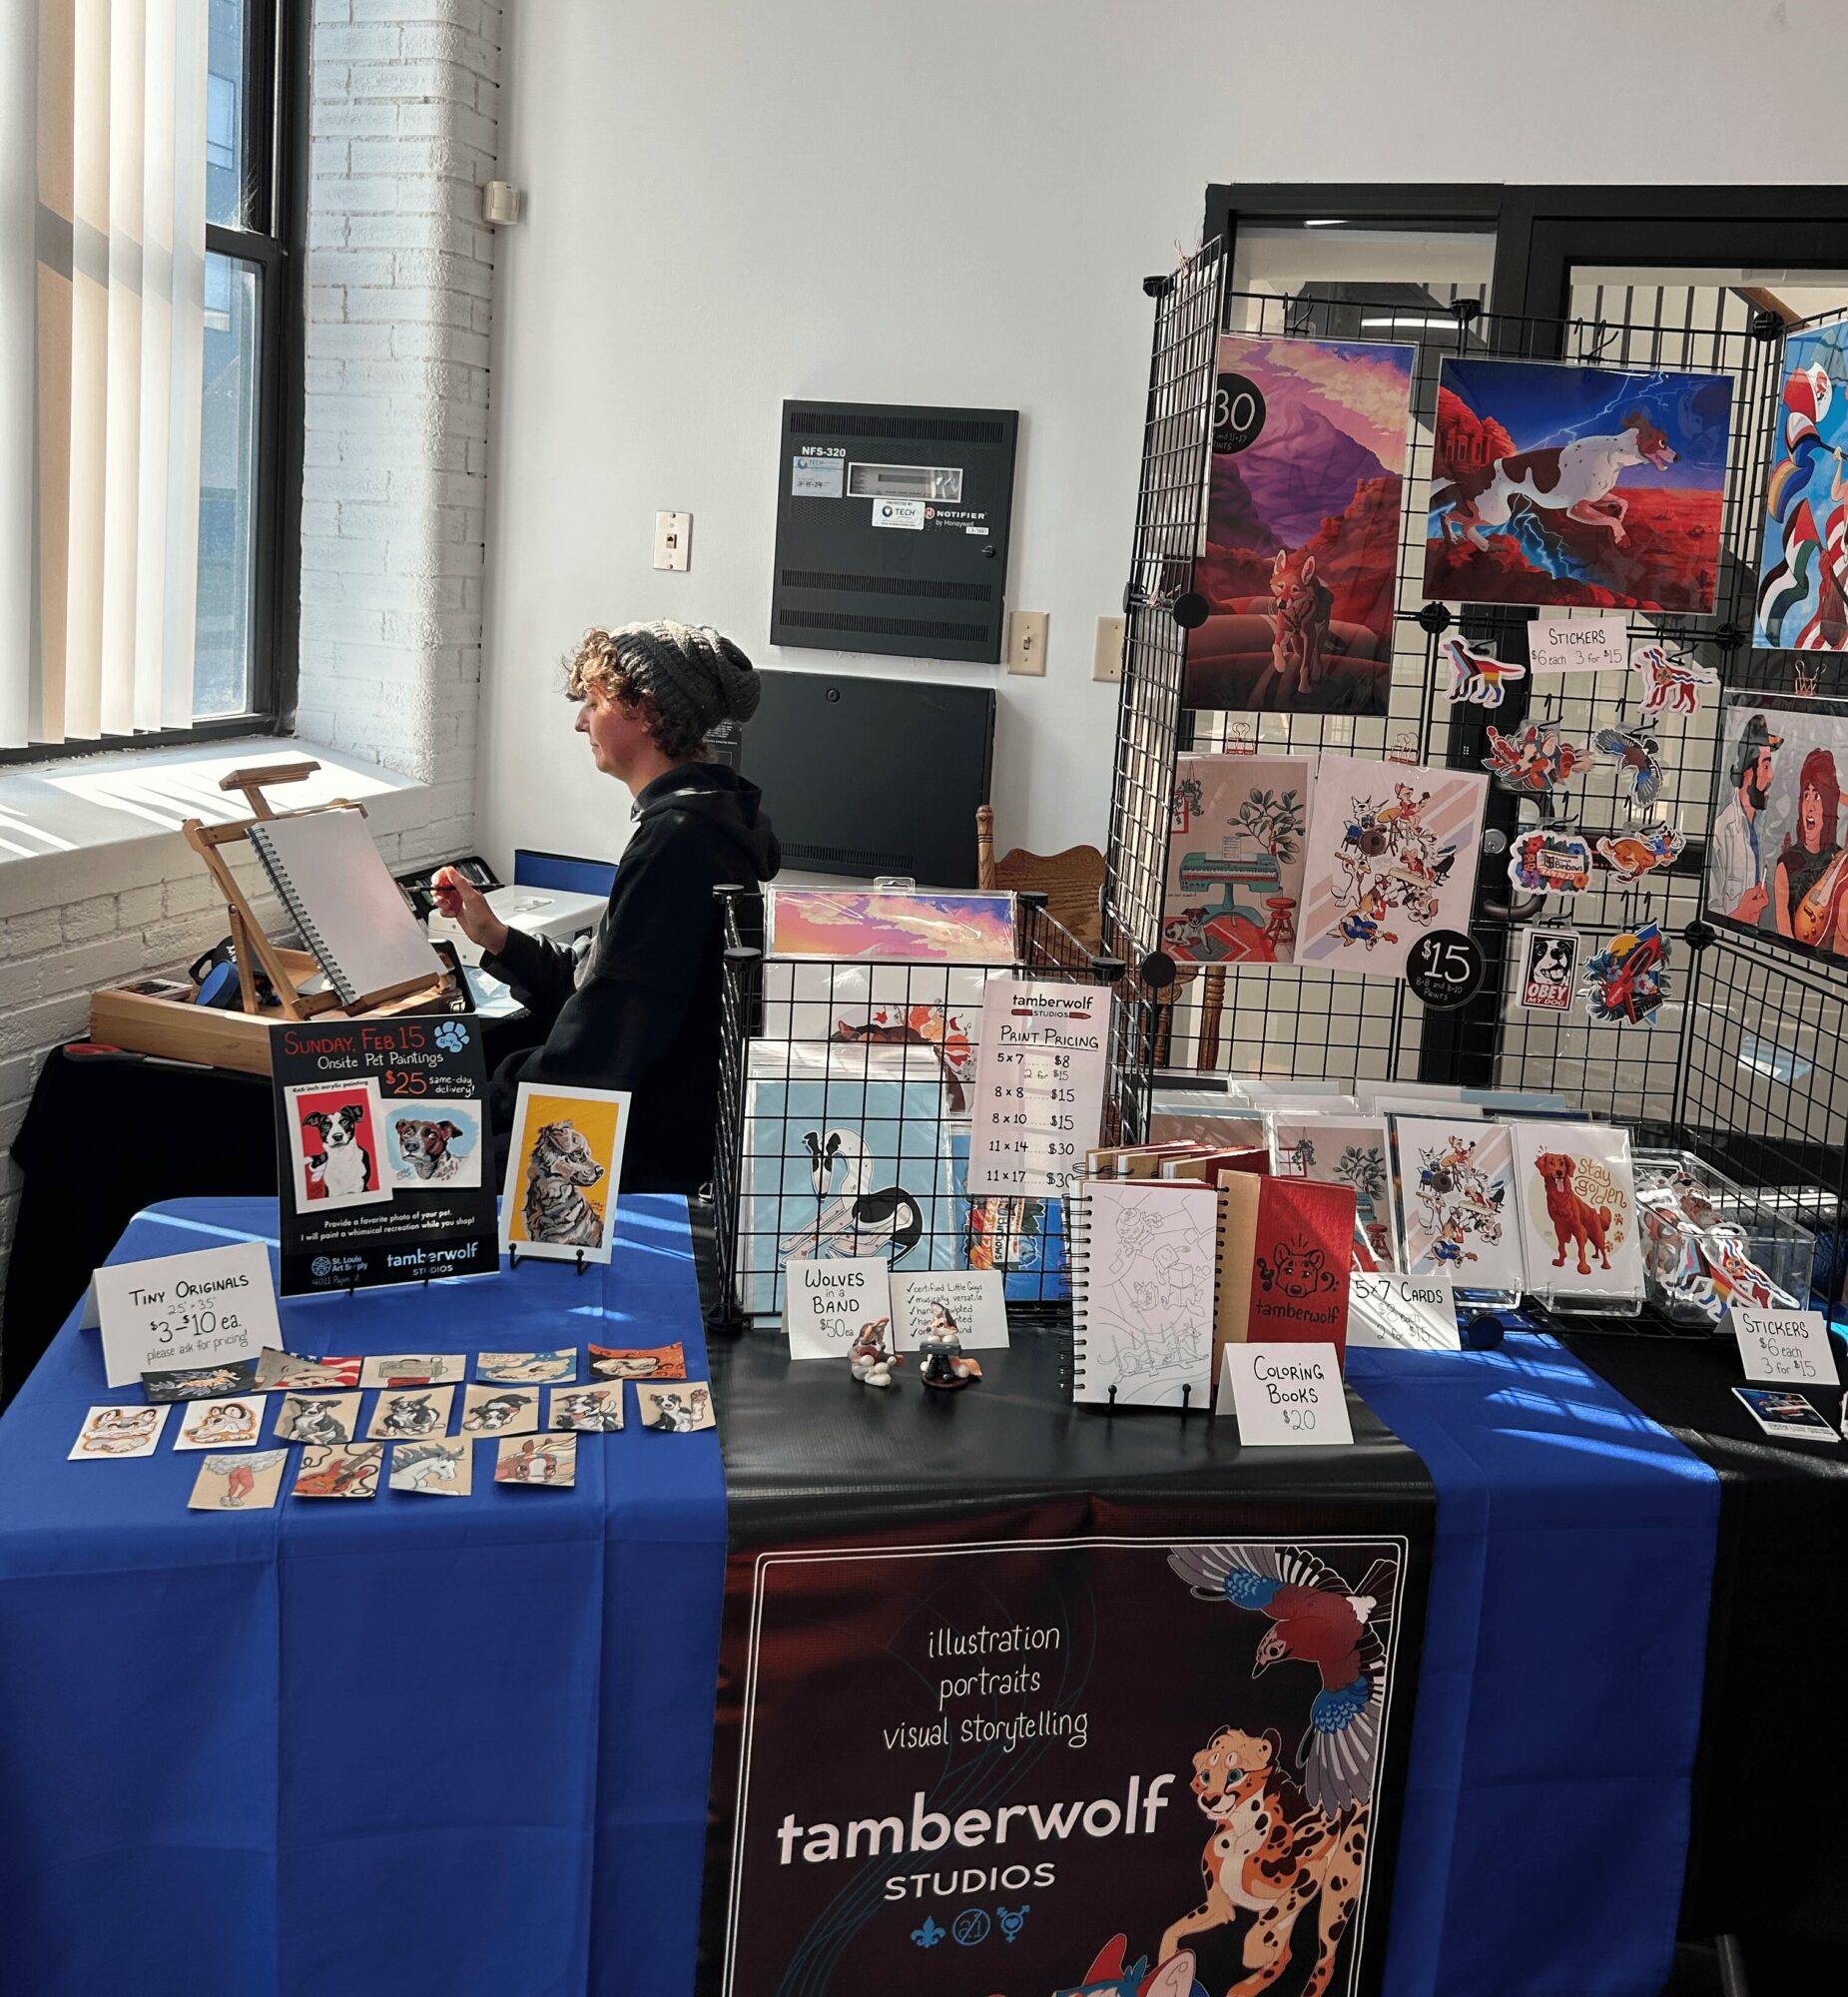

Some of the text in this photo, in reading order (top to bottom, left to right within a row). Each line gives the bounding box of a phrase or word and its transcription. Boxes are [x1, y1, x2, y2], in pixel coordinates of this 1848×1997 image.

[802, 445, 847, 457] NFS-320
[895, 508, 916, 517] TECH
[936, 510, 985, 520] NOTIFIER
[943, 519, 975, 528] Honeywell
[1548, 627, 1606, 646] STICKERS
[1531, 648, 1623, 666] $6 each 3 for $15
[1421, 939, 1471, 984] $15
[1528, 984, 1568, 1000] OBEY
[1011, 994, 1094, 1010] tamberwolf
[1543, 998, 1565, 1006] DOG
[1033, 1009, 1069, 1018] STUDIOS
[360, 1027, 395, 1051] FEB
[398, 1025, 425, 1049] 15
[1000, 1024, 1099, 1048] PRINT PRICING
[317, 1051, 444, 1070] Onsite Pet Paintings
[1054, 1054, 1070, 1068] $8
[385, 1069, 473, 1095] $25 same-day
[1023, 1068, 1069, 1081] 2 for $15
[434, 1084, 476, 1098] delivery!
[1050, 1088, 1075, 1102] $15
[1049, 1114, 1074, 1130] $15
[1047, 1142, 1075, 1156] $30
[1574, 1179, 1627, 1209] golden
[323, 1219, 351, 1229] Provide
[359, 1215, 388, 1225] favorite
[389, 1213, 411, 1224] photo
[411, 1211, 420, 1220] of
[420, 1210, 437, 1220] your
[306, 1232, 319, 1241] will
[319, 1231, 339, 1242] paint
[347, 1226, 383, 1237] whimsical
[383, 1222, 420, 1233] recreation
[420, 1219, 440, 1229] while
[440, 1219, 455, 1229] you
[342, 1255, 363, 1264] Louis
[805, 1268, 865, 1288] WOLVES
[914, 1281, 983, 1294] certified Little Guys
[129, 1273, 250, 1307] TINY ORIGINALS
[825, 1287, 846, 1298] in a
[916, 1293, 983, 1305] musically versatile
[1400, 1281, 1444, 1304] CARDS
[813, 1295, 860, 1314] BAND
[1255, 1299, 1341, 1324] tamberwolf
[1376, 1324, 1432, 1343] 2 for $15
[1742, 1313, 1809, 1339] STICKERS
[147, 1328, 249, 1365] please ask for pricing!
[1759, 1337, 1803, 1359] $6 each
[1760, 1357, 1817, 1378] 3 for $15
[1266, 1383, 1320, 1405] BOOKS
[1282, 1409, 1317, 1431] $20
[927, 1624, 1061, 1660] illustration
[937, 1664, 1041, 1711] portraits
[882, 1708, 1089, 1753] visual storytelling
[777, 1772, 1176, 1865] tamberwolf
[884, 1861, 1056, 1901] STUDIOS
